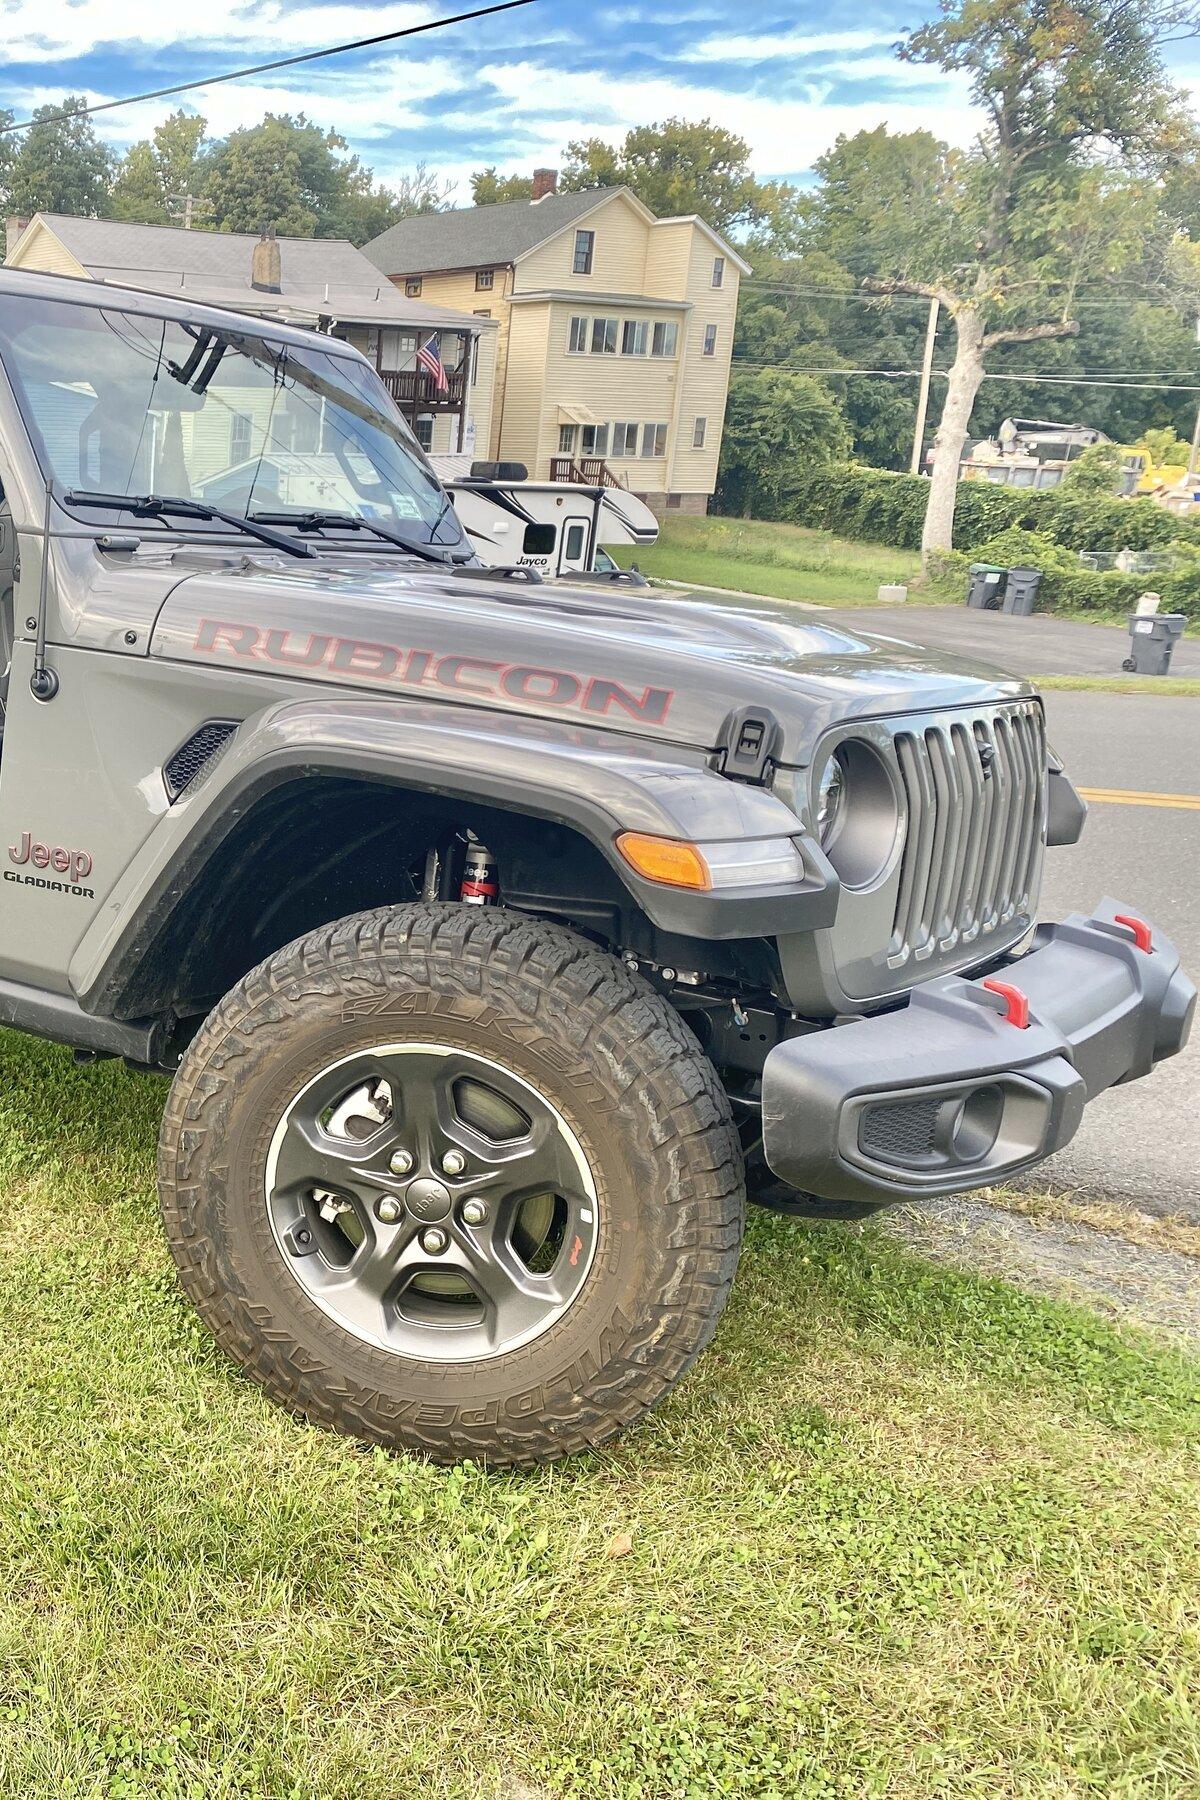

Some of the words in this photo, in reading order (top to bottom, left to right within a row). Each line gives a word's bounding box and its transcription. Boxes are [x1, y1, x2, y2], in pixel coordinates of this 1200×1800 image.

[516, 556, 548, 568] Jayco
[193, 618, 674, 724] RUBICON
[8, 831, 92, 883] Jeep
[464, 865, 489, 880] Jeep
[3, 870, 95, 899] GLADIATOR
[331, 990, 619, 1114] FALKEN
[415, 1188, 441, 1213] Jeep
[323, 1303, 635, 1428] WILDPEAK
